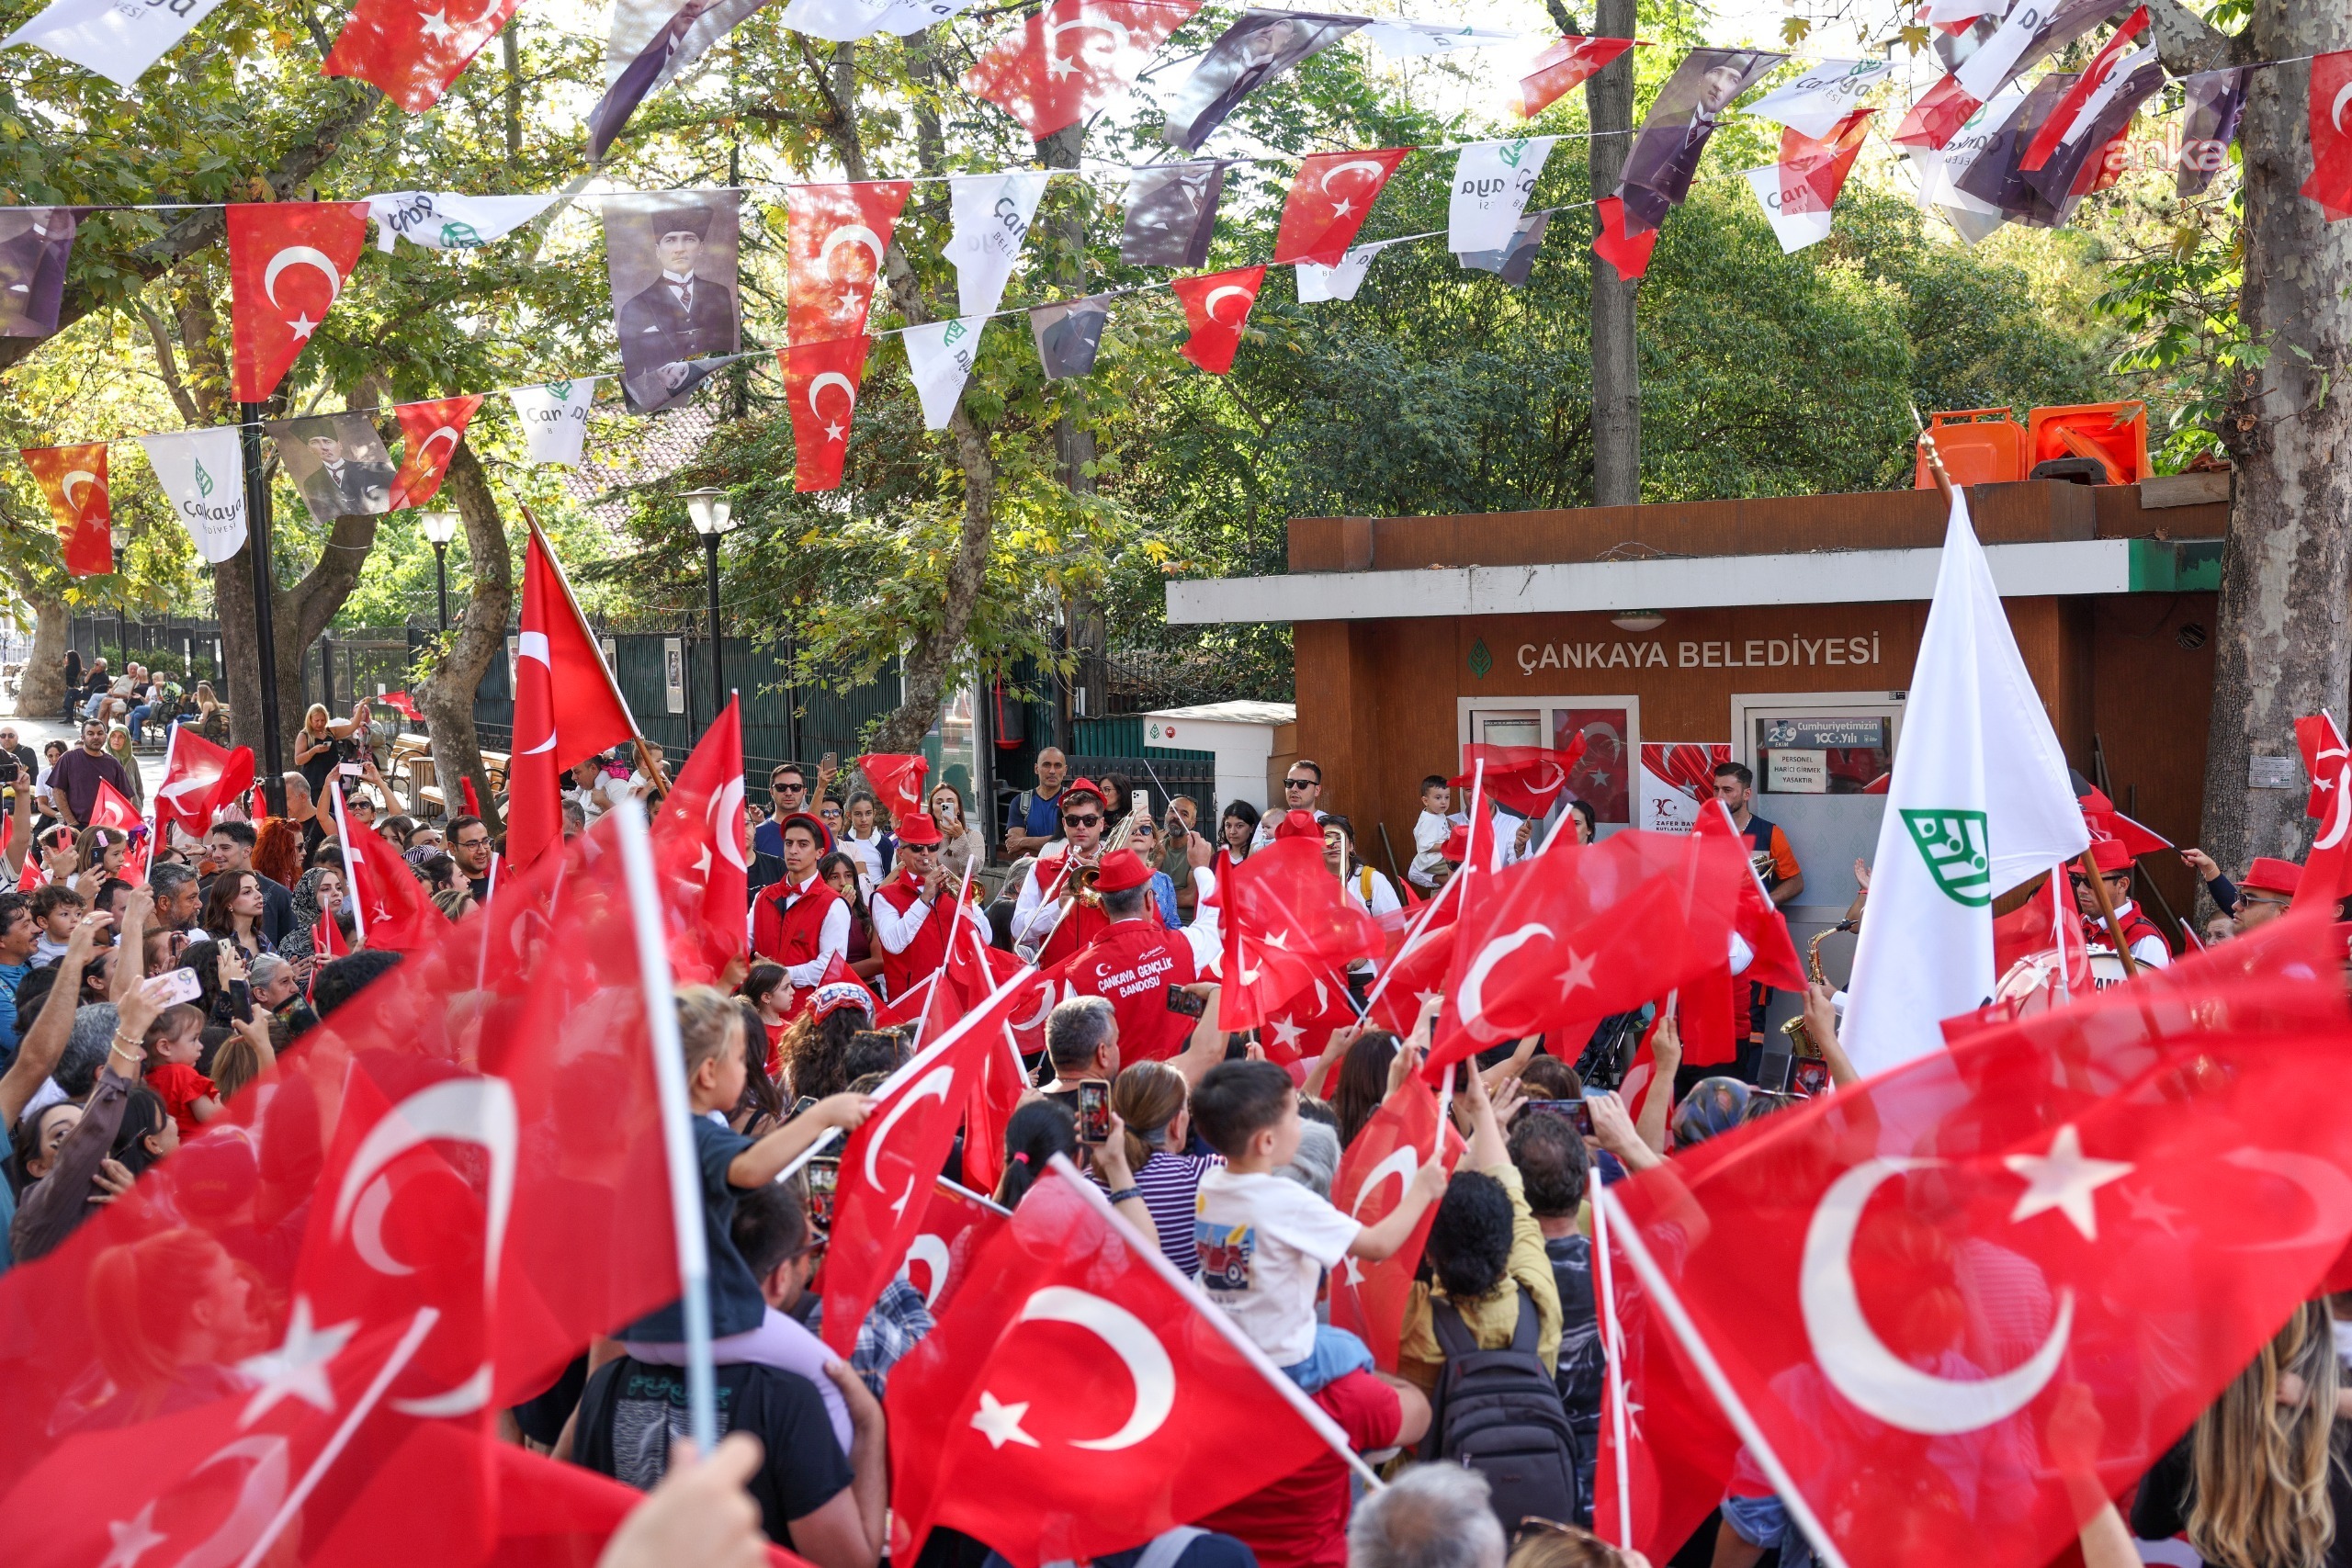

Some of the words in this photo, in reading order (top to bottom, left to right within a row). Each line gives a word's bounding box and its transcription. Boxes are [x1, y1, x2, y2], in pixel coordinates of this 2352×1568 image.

[1517, 641, 1669, 676] ÇANKAYA
[1679, 630, 1880, 669] BELEDİYESİ
[1797, 720, 1878, 733] Cumhuriyetimizin
[1774, 740, 1790, 749] EKİM
[1781, 755, 1814, 763] PERSONEL
[1796, 765, 1821, 773] GİRMEK
[1782, 776, 1813, 784] YASAKTIR
[1098, 969, 1136, 995] ÇANKAYA
[1136, 956, 1174, 976] GENÇLİK
[1119, 975, 1160, 998] BANDOSU
